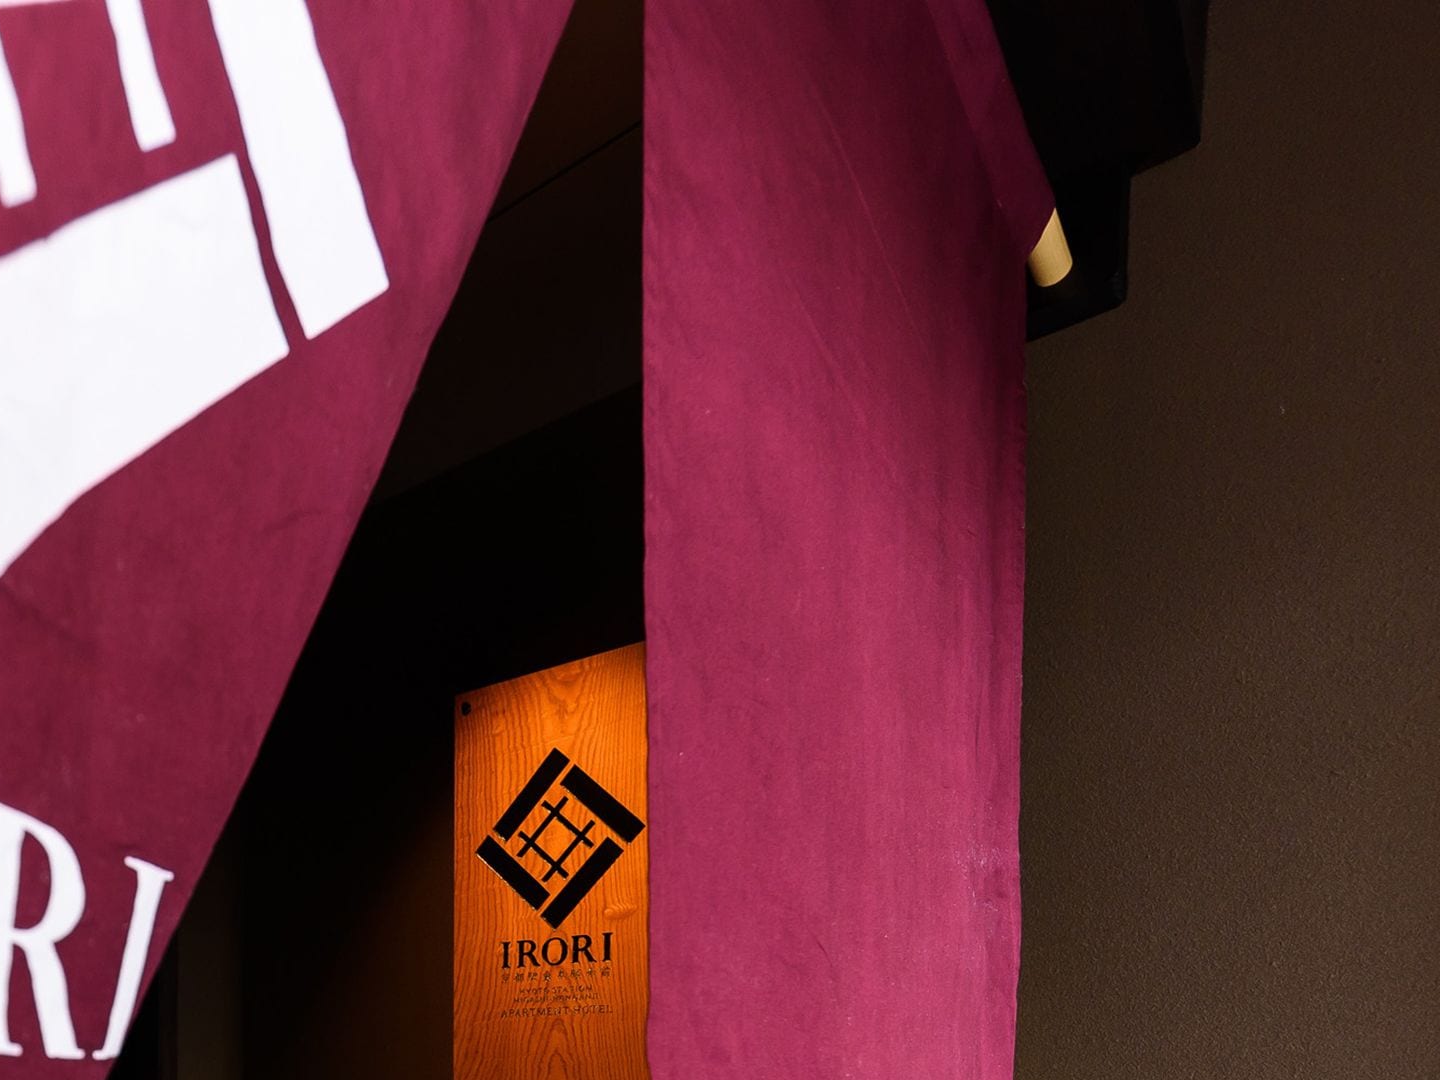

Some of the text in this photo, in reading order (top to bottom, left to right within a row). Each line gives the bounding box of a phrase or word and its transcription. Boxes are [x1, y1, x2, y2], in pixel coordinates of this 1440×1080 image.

[501, 931, 613, 969] IRORI
[501, 1003, 614, 1019] APARTMENT HOTEL
